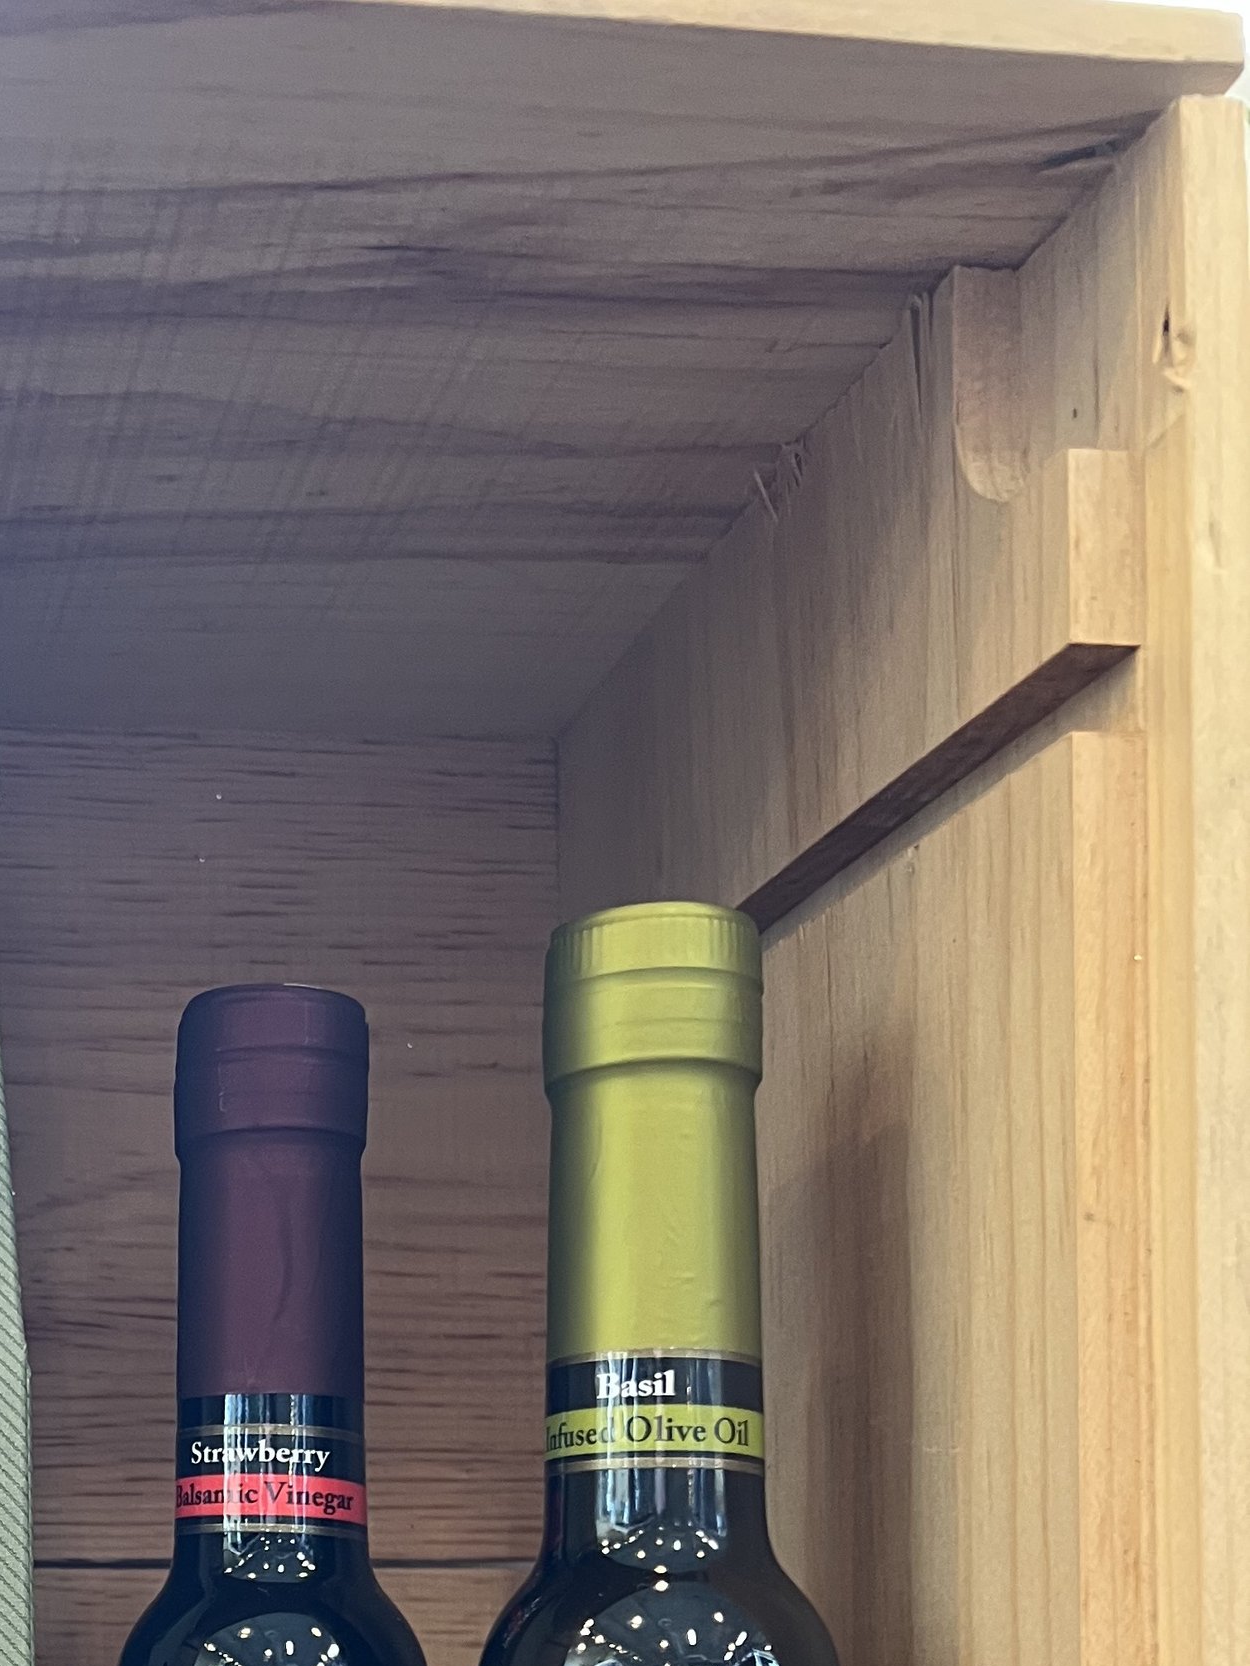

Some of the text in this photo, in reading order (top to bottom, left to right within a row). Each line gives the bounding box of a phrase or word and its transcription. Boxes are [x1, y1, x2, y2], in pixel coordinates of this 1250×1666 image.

[596, 1369, 676, 1400] Basil
[626, 1415, 707, 1443] Olive
[714, 1416, 749, 1447] Oil
[191, 1438, 330, 1472] Strawberry
[264, 1480, 354, 1515] Vinegar
